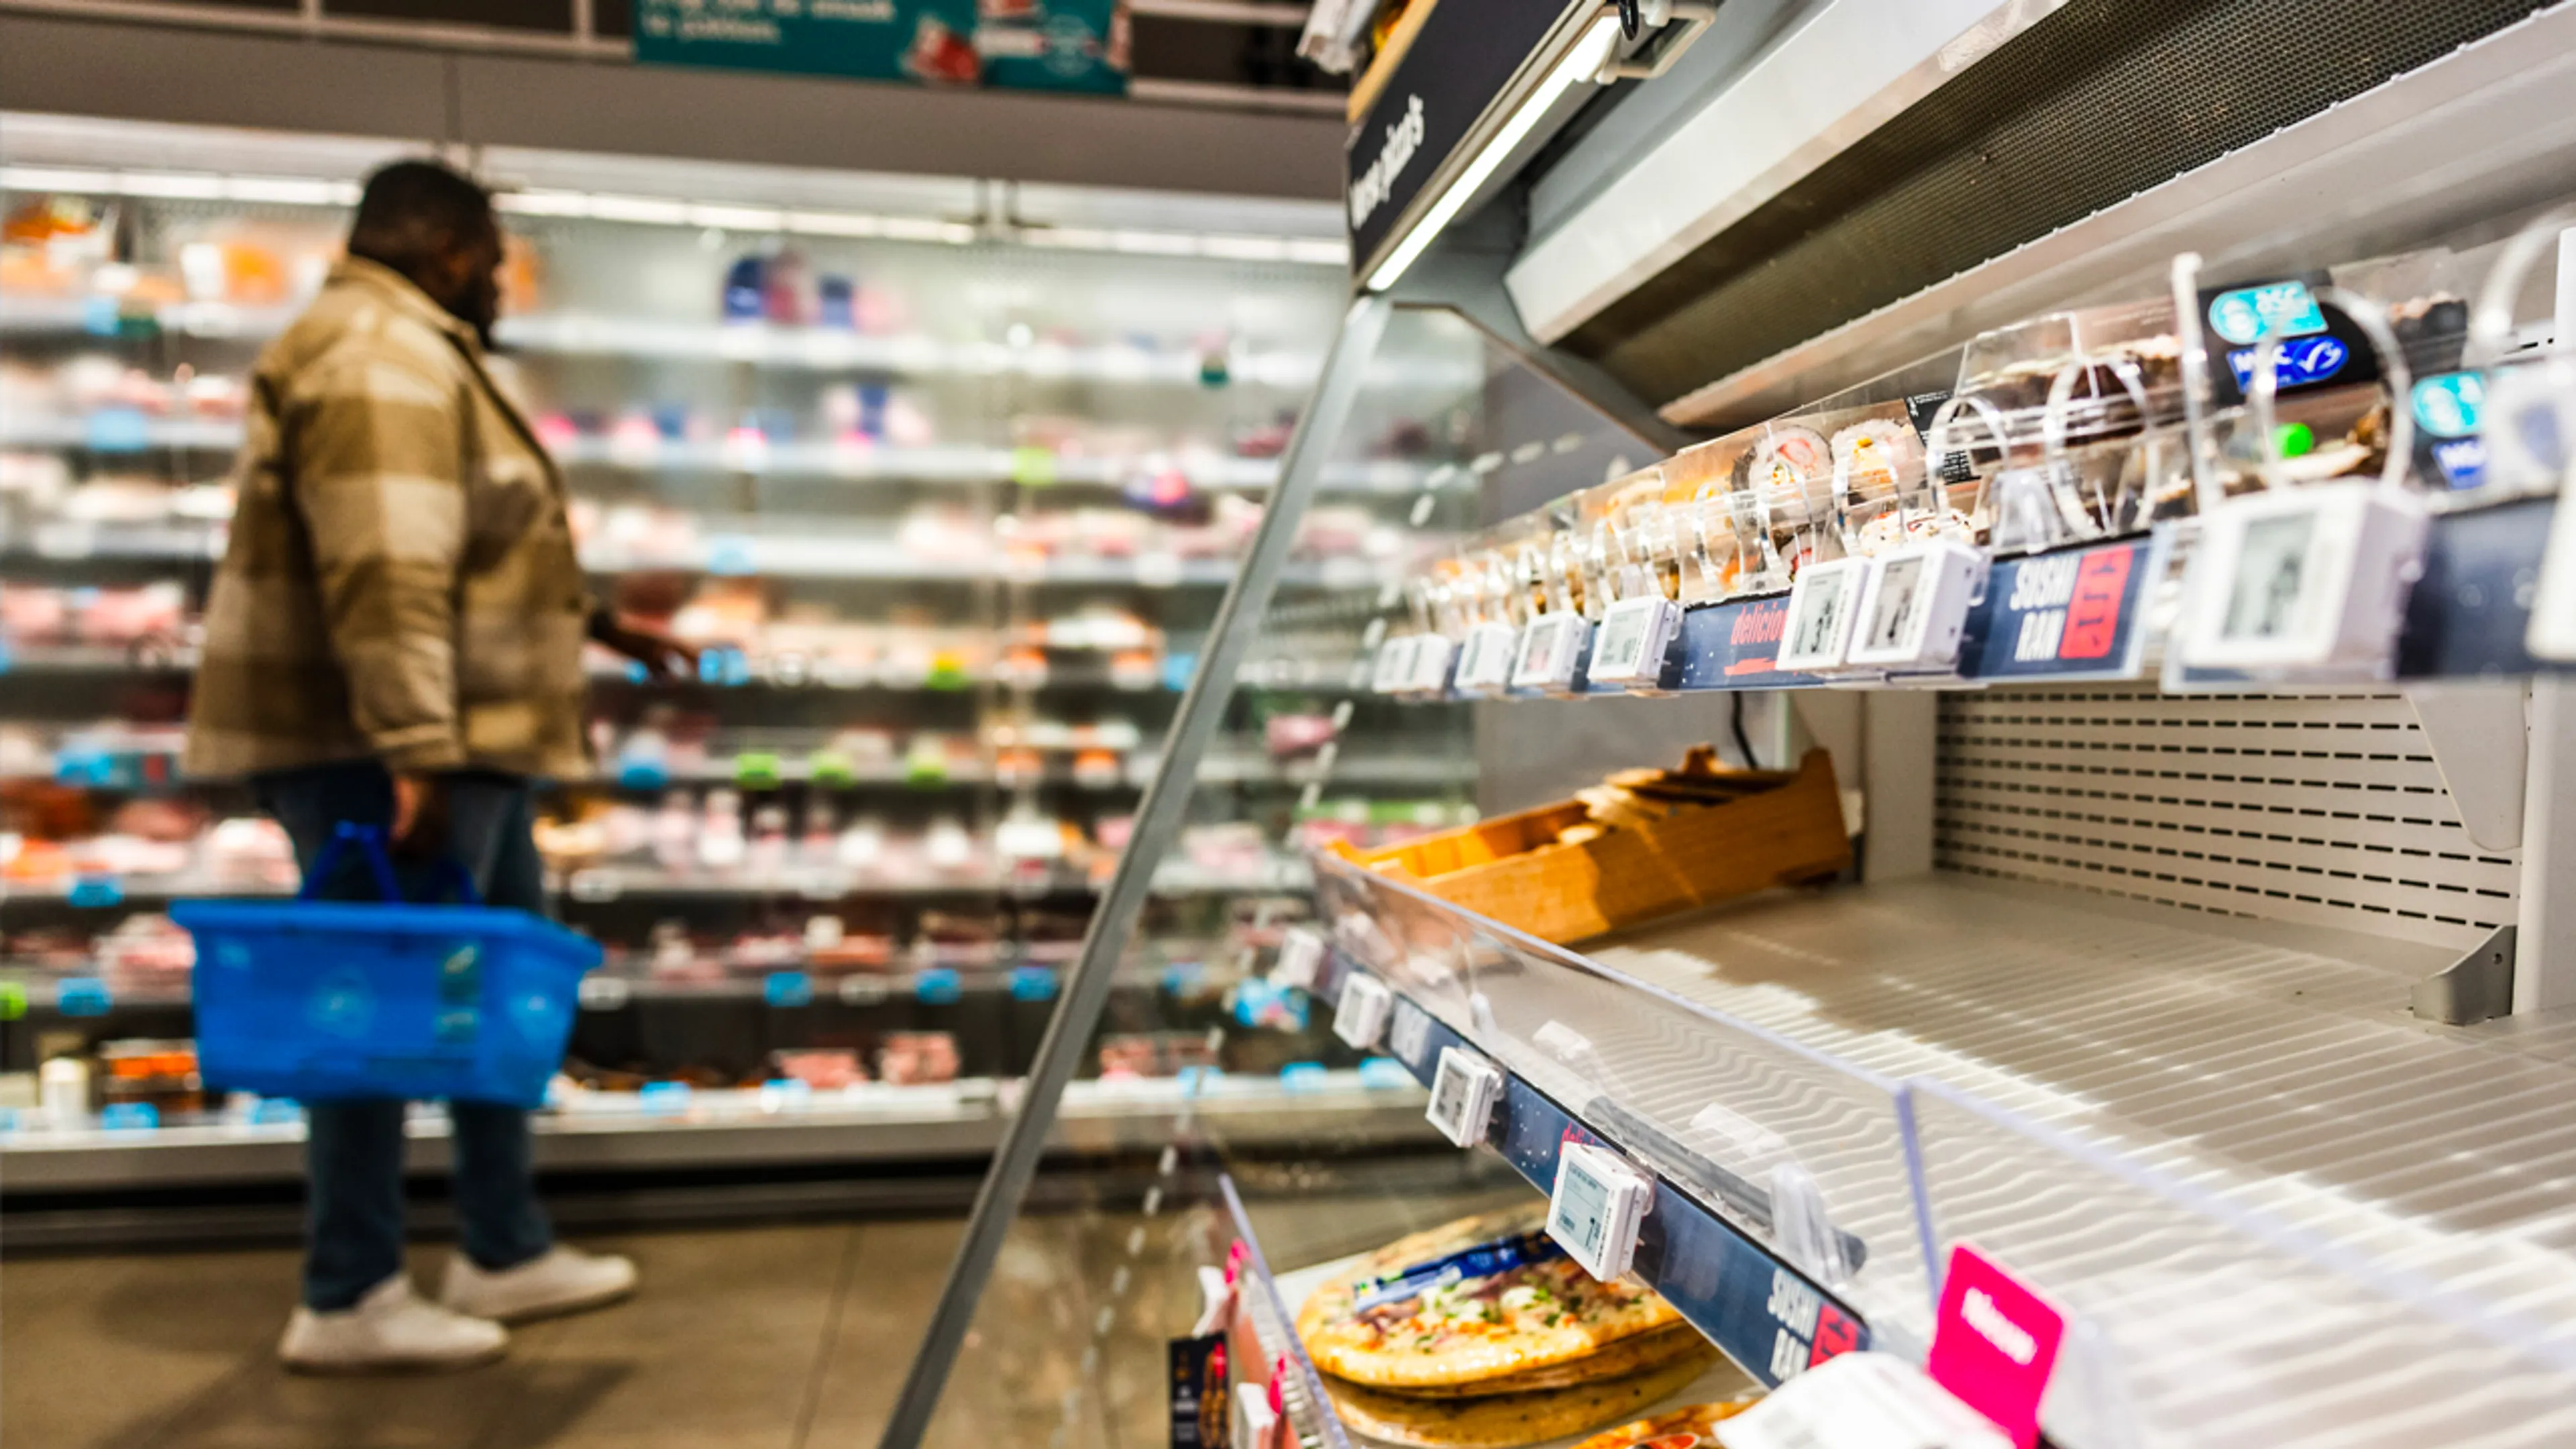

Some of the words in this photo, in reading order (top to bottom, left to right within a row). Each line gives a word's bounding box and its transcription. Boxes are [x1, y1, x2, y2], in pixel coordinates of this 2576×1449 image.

[2009, 555, 2080, 612] SUSHI
[1730, 601, 1790, 645] delicio
[1767, 1268, 1821, 1342] SUSHI
